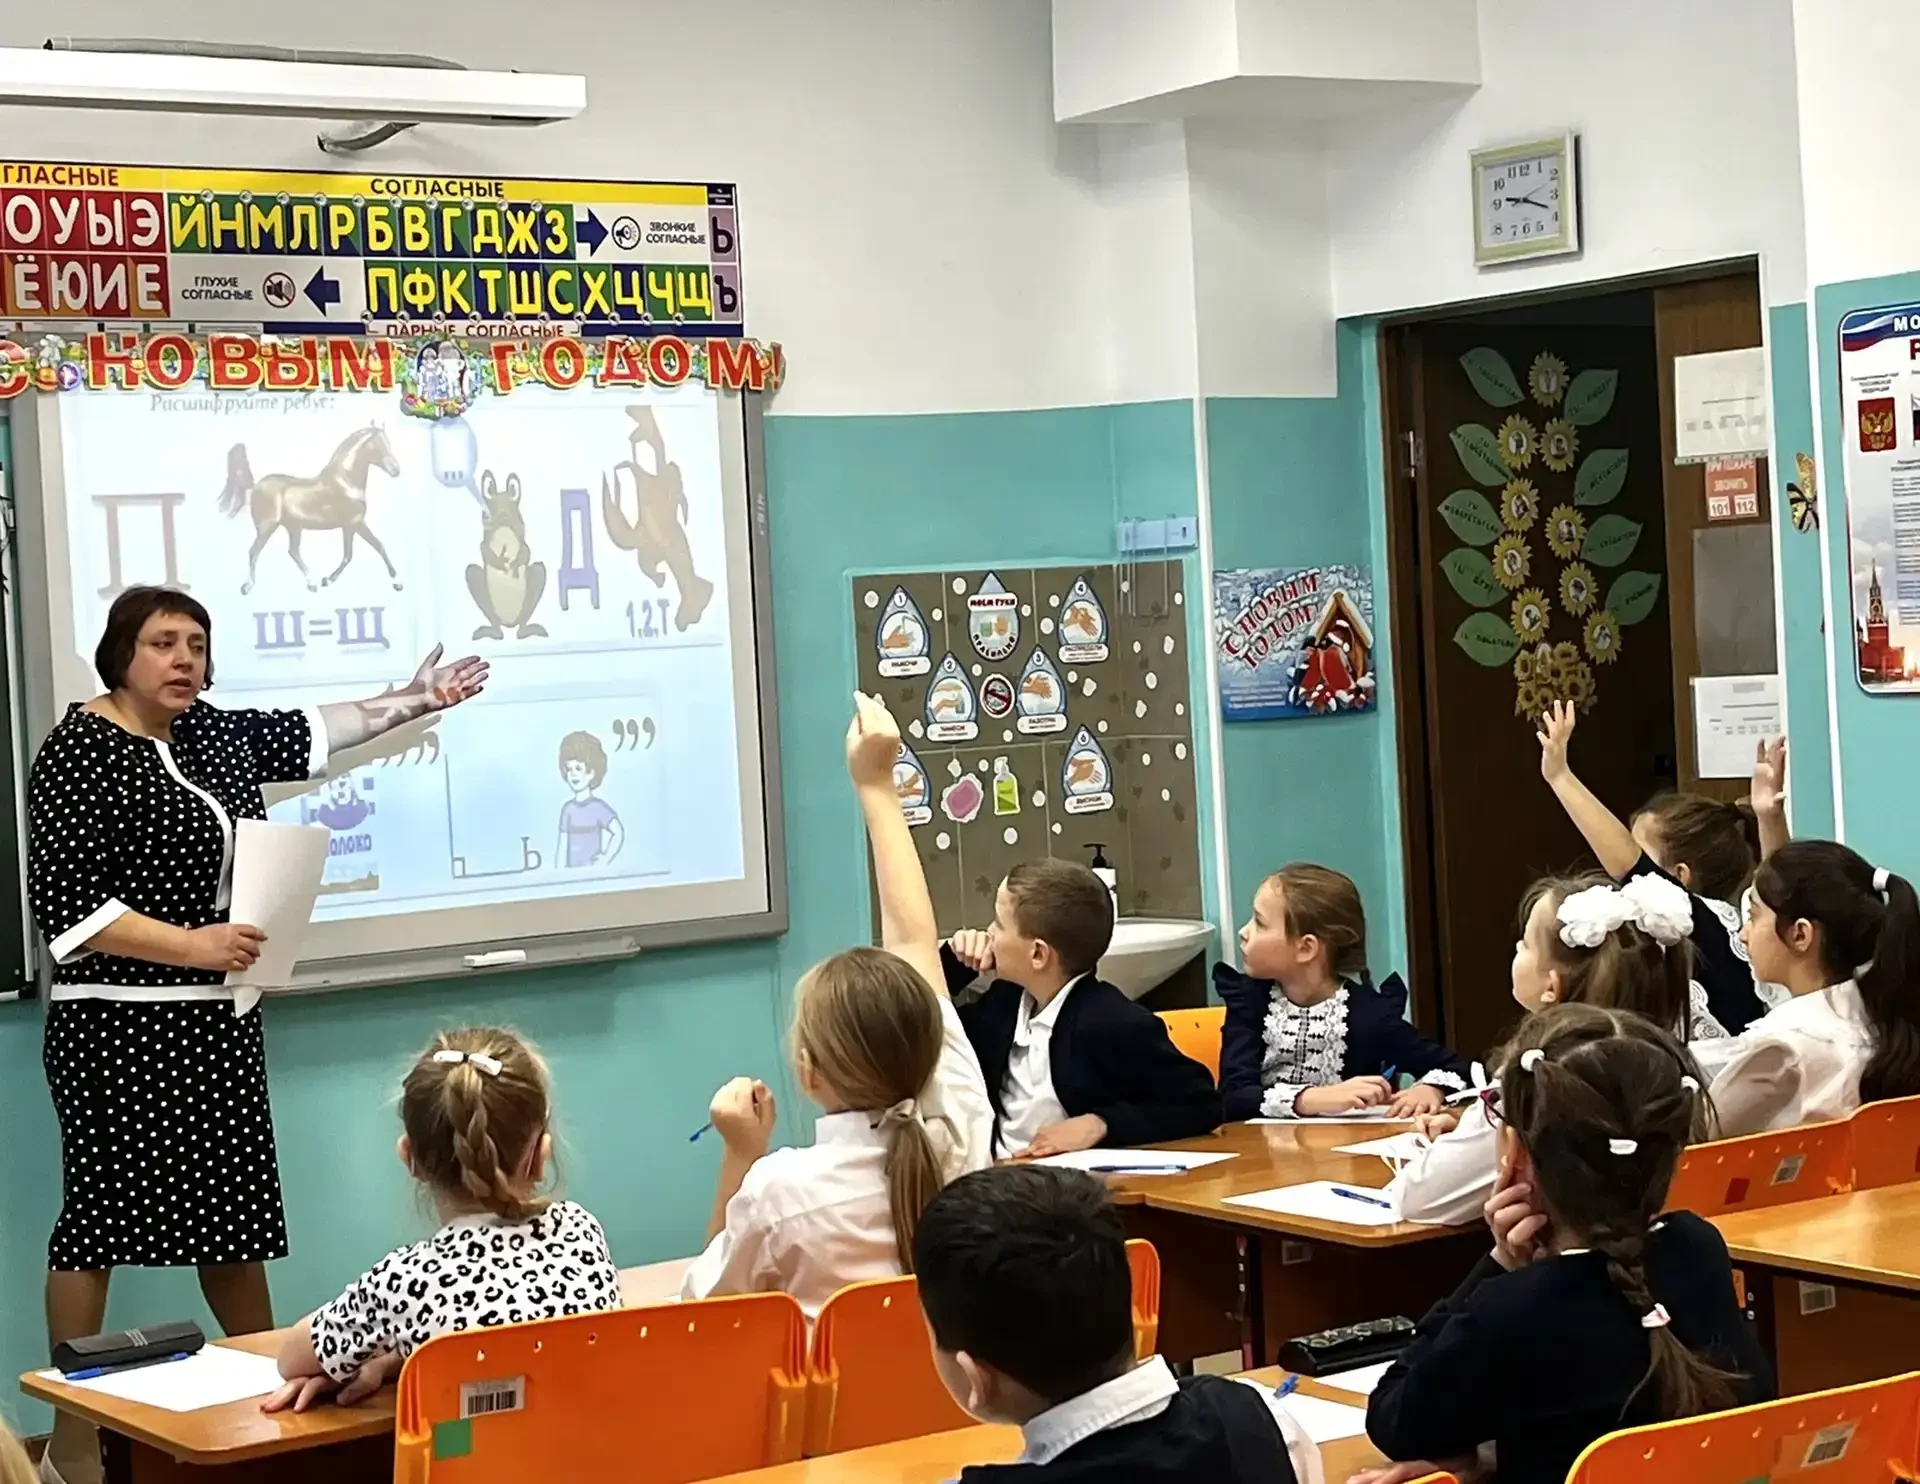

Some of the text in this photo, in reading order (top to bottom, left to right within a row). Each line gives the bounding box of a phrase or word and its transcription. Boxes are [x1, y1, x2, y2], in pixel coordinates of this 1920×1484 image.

[1508, 166, 1517, 178] 11
[1519, 163, 1530, 176] 12
[1537, 161, 1543, 173] 1
[3, 165, 119, 186] ГЛАСНЫЕ
[1549, 168, 1559, 181] 2
[371, 178, 504, 198] СОГЛАСНЫЕ
[1493, 178, 1505, 191] 10
[1549, 188, 1559, 200] 3
[1492, 199, 1502, 211] 9
[648, 221, 696, 233] ЗВОНКИЕ
[1493, 225, 1502, 235] 8
[1510, 225, 1518, 236] 7
[1522, 222, 1531, 234] 6
[1535, 221, 1544, 232] 5
[645, 234, 706, 246] СОГЛАСНЫЕ
[194, 275, 239, 288] ГЛУХИЕ
[181, 288, 254, 301] СОГЛАСНЫЕ
[386, 324, 564, 338] ПАРНЫЕ СОГЛАСНЫЕ
[86, 333, 395, 392] НОВЫМ
[490, 336, 784, 394] ГОДОМ!
[151, 391, 278, 416] Расшифруйте
[1711, 500, 1755, 516] 101 112
[1235, 570, 1322, 639] НОВЫМ
